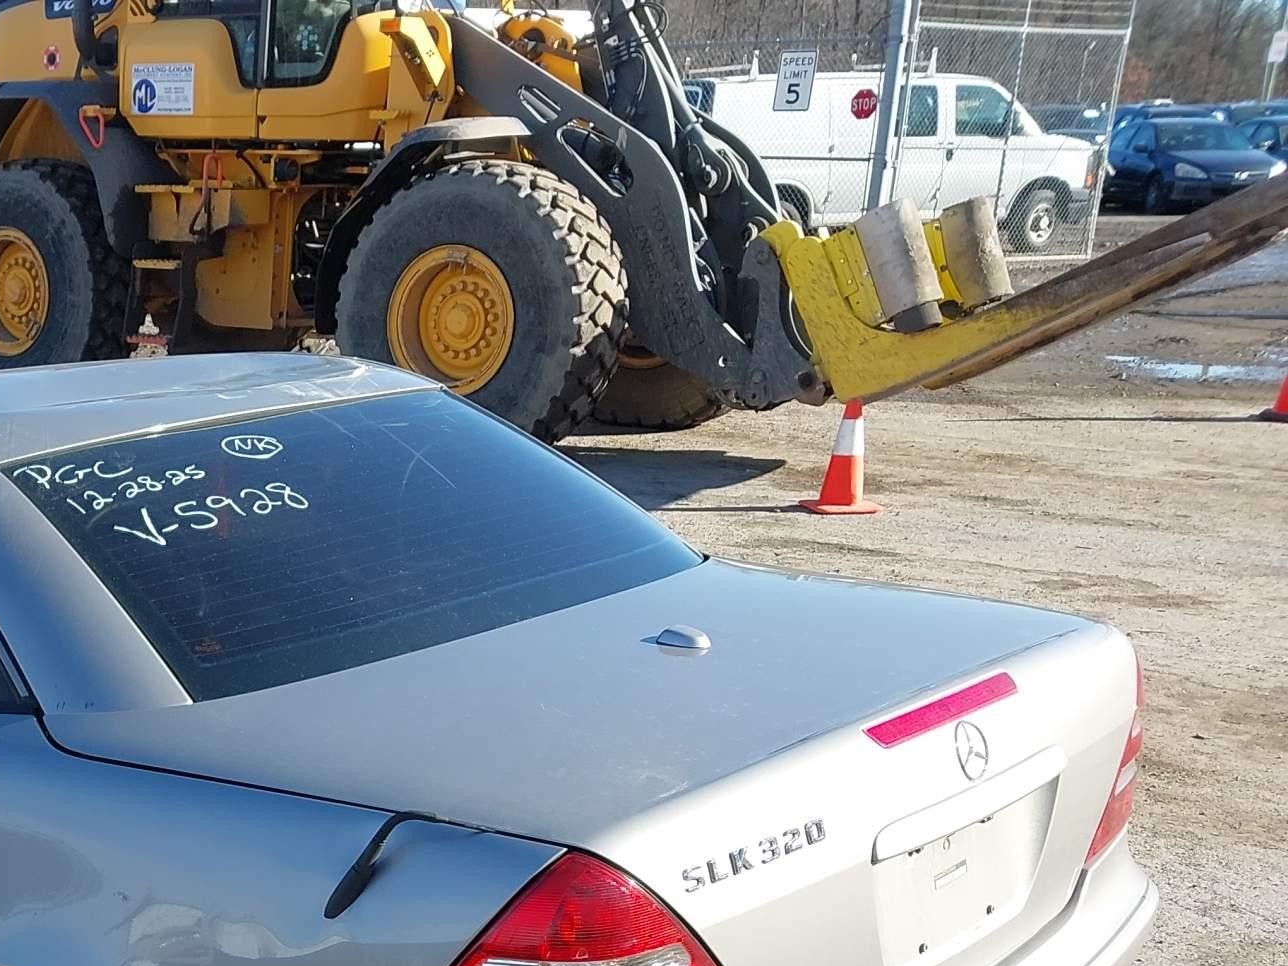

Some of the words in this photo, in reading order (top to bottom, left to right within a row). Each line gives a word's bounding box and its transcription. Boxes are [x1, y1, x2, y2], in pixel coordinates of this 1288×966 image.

[782, 57, 814, 67] SPEED
[783, 69, 809, 80] LIMIT
[785, 82, 801, 105] 5
[852, 96, 877, 112] STOP
[66, 464, 206, 514] 12-28-25
[114, 483, 309, 545] V-5928
